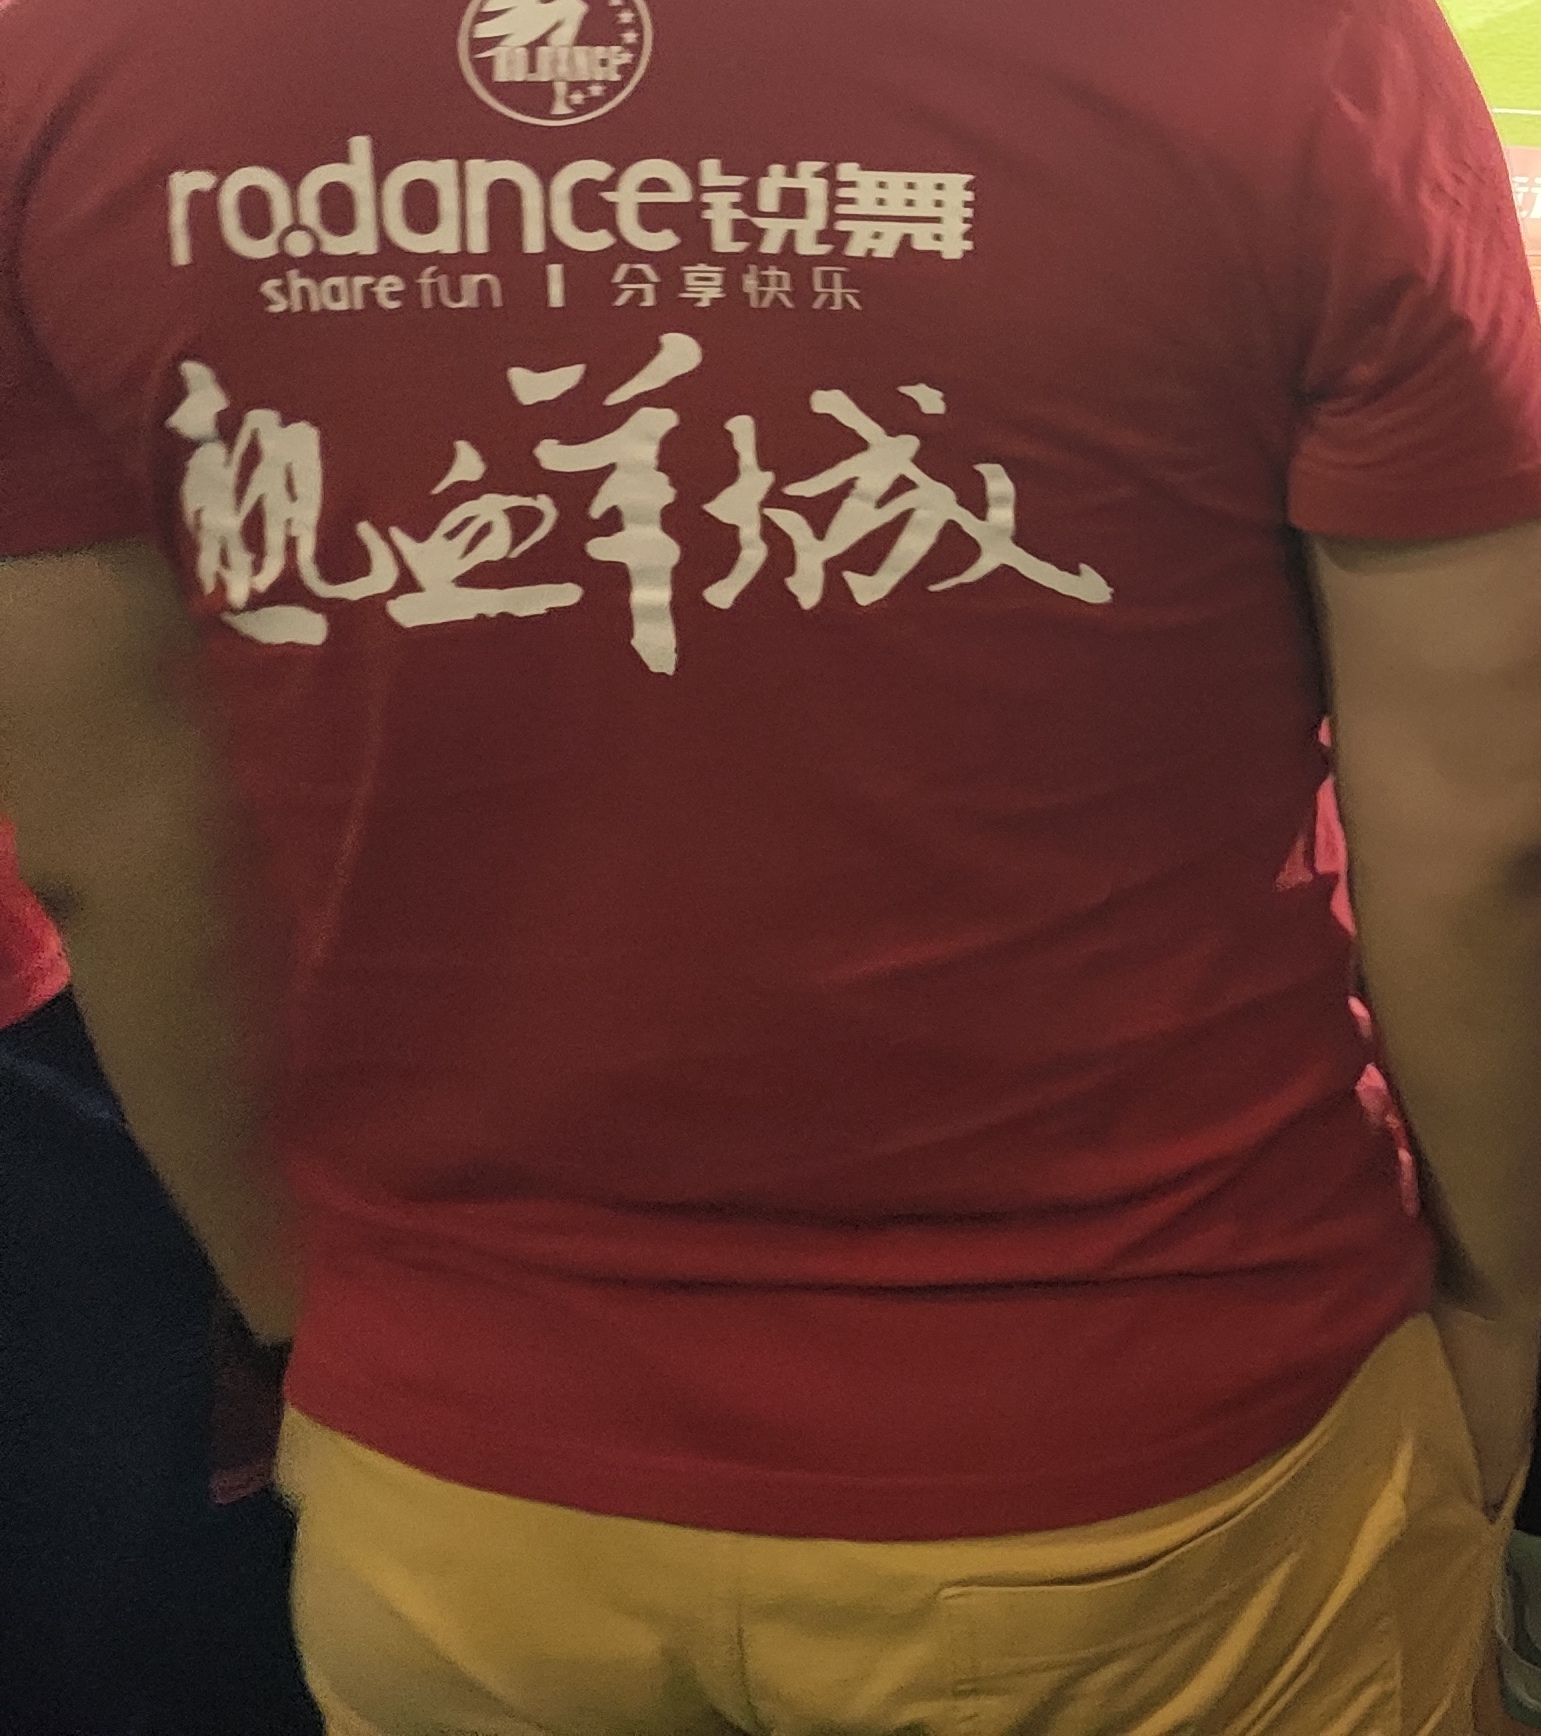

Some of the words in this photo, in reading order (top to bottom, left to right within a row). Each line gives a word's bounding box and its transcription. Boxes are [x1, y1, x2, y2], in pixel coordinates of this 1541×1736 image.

[697, 158, 976, 261] 锐舞
[259, 269, 405, 314] share
[416, 265, 503, 310] fun
[611, 263, 863, 311] 分享快乐
